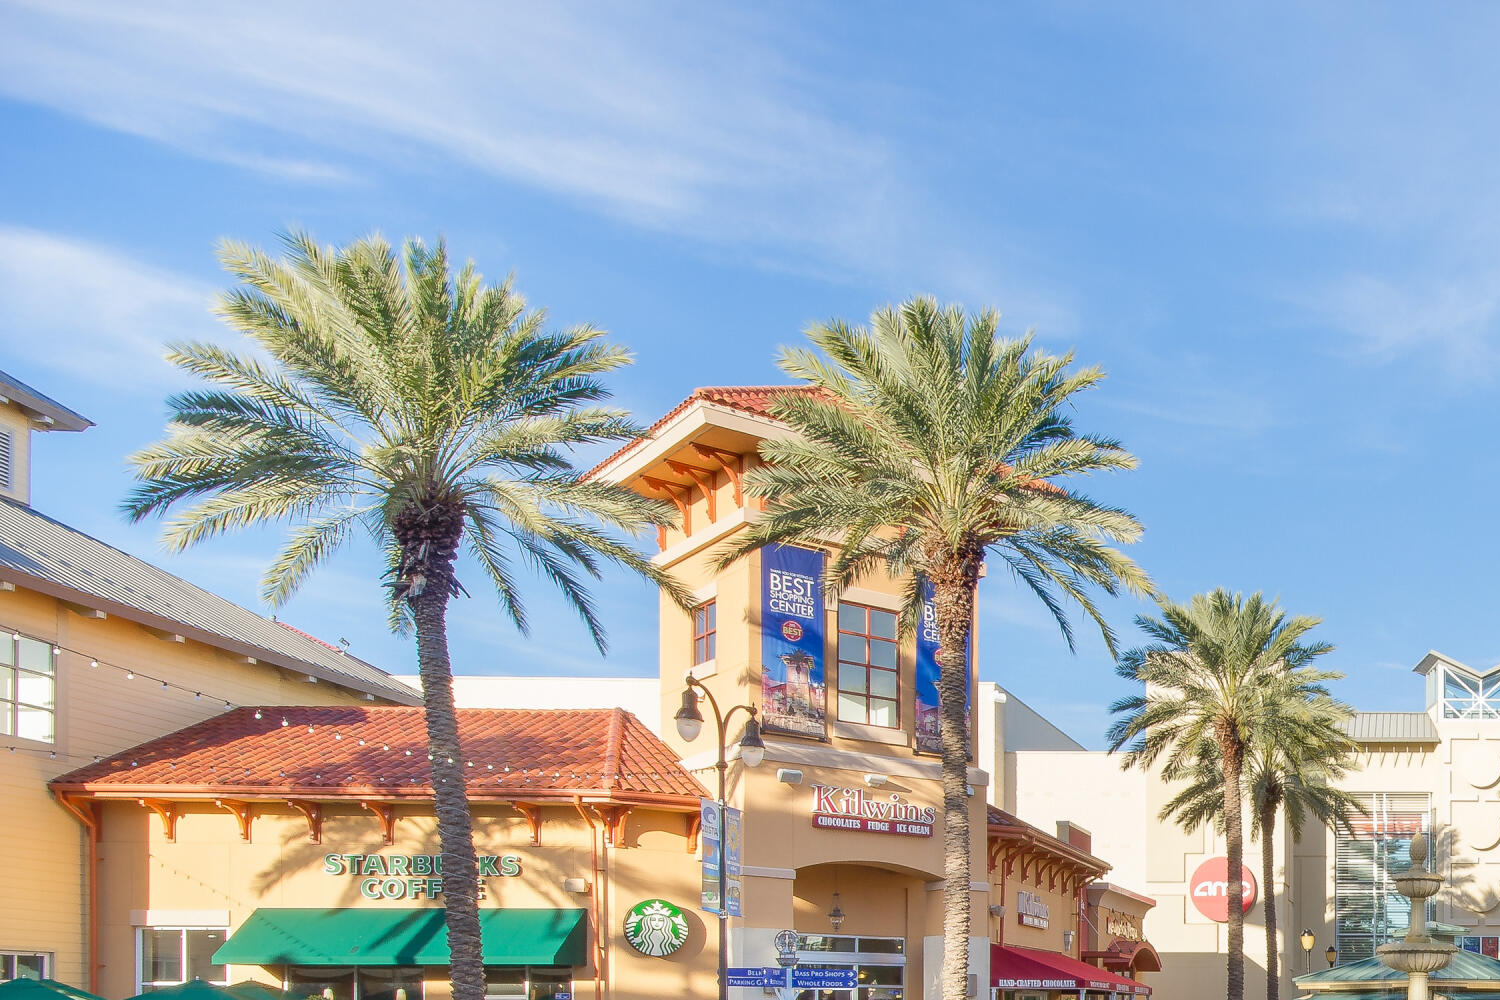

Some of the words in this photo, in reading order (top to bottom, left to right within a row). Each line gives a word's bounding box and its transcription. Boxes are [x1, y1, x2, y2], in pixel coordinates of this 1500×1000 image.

[770, 573, 814, 597] BEST
[769, 590, 815, 605] SHOPPING
[769, 599, 814, 617] CENTER
[782, 626, 803, 637] BEST
[810, 784, 936, 824] Kilwins
[818, 816, 861, 829] CHOCOLATES
[867, 821, 889, 831] FUDGE
[896, 823, 907, 833] ICE
[908, 825, 930, 835] CREAM
[324, 853, 522, 877] STARBKS
[361, 877, 487, 900] COFF
[729, 978, 755, 986] PARKING
[824, 970, 846, 978] SHOPS
[999, 978, 1041, 987] HAND-CRAFTED
[1042, 979, 1076, 988] CHOCOLATES
